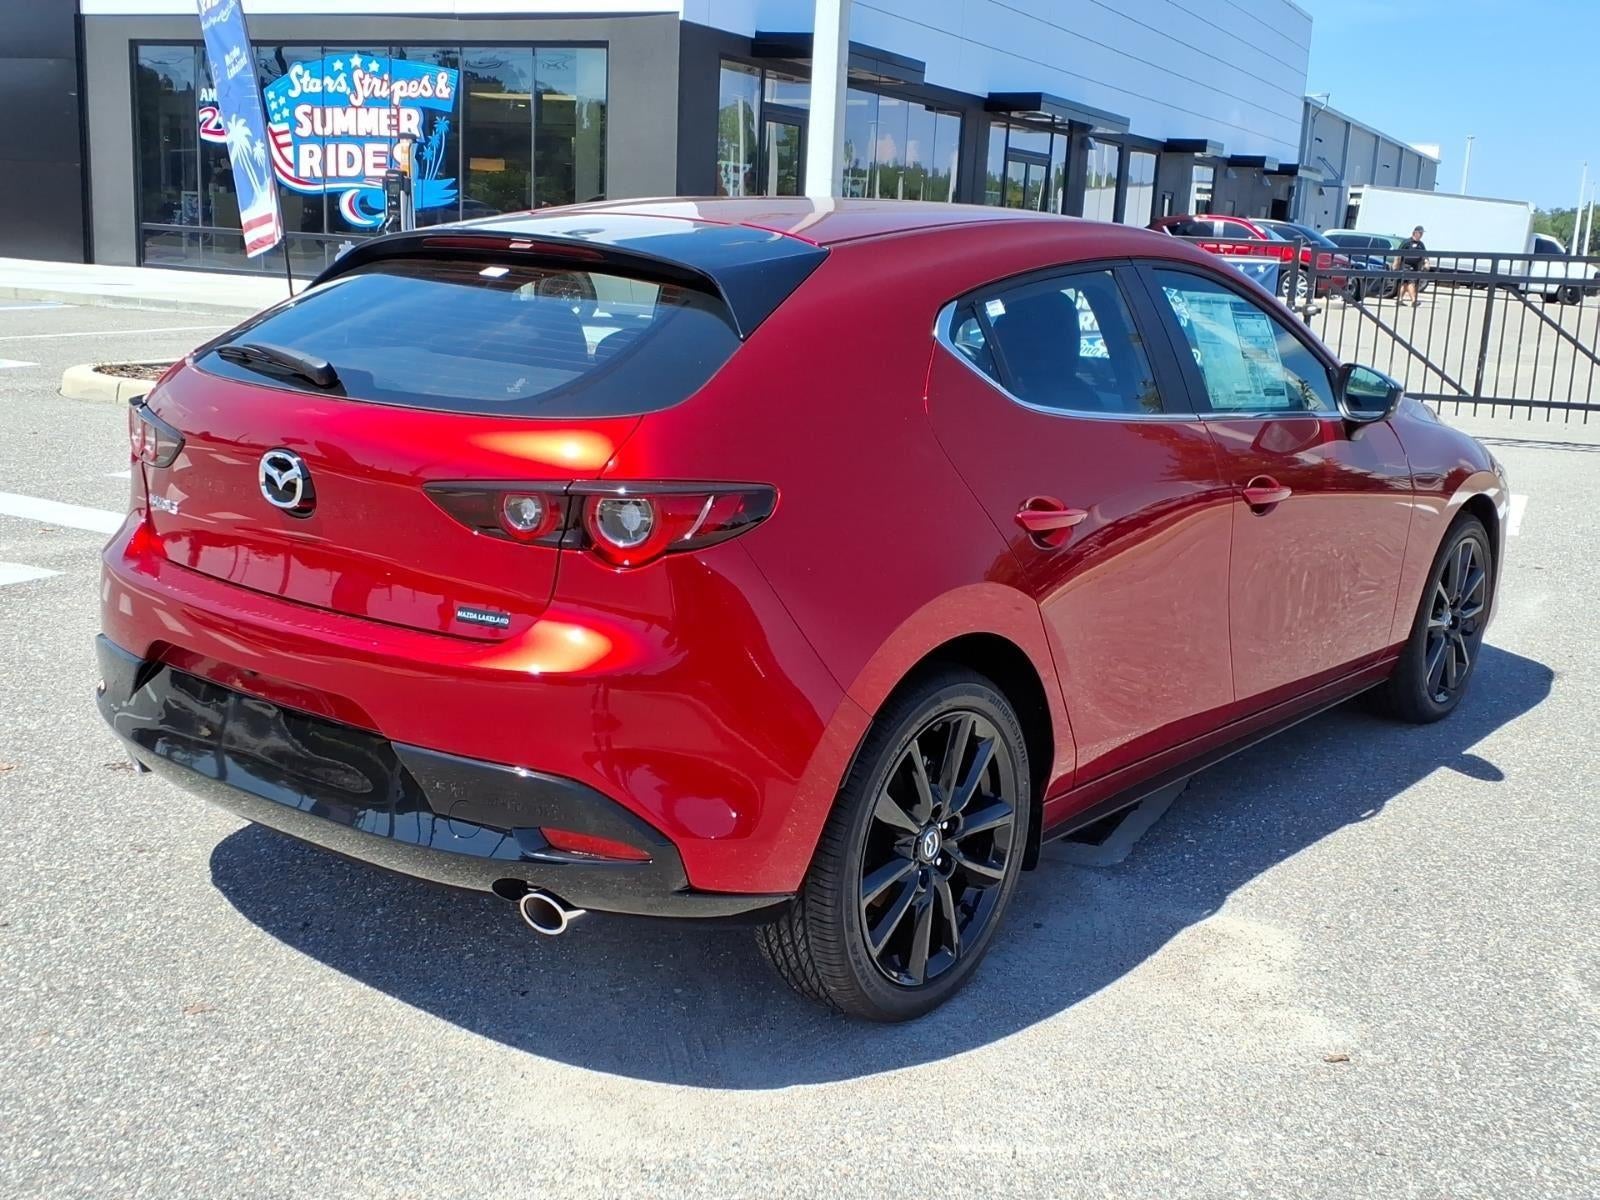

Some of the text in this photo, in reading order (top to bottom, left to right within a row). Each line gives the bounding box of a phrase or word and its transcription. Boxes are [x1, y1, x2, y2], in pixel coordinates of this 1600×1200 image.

[350, 69, 433, 106] Stripes
[434, 71, 451, 98] &
[295, 104, 420, 137] SUMMER
[458, 611, 509, 624] MAZDA LAKELAND
